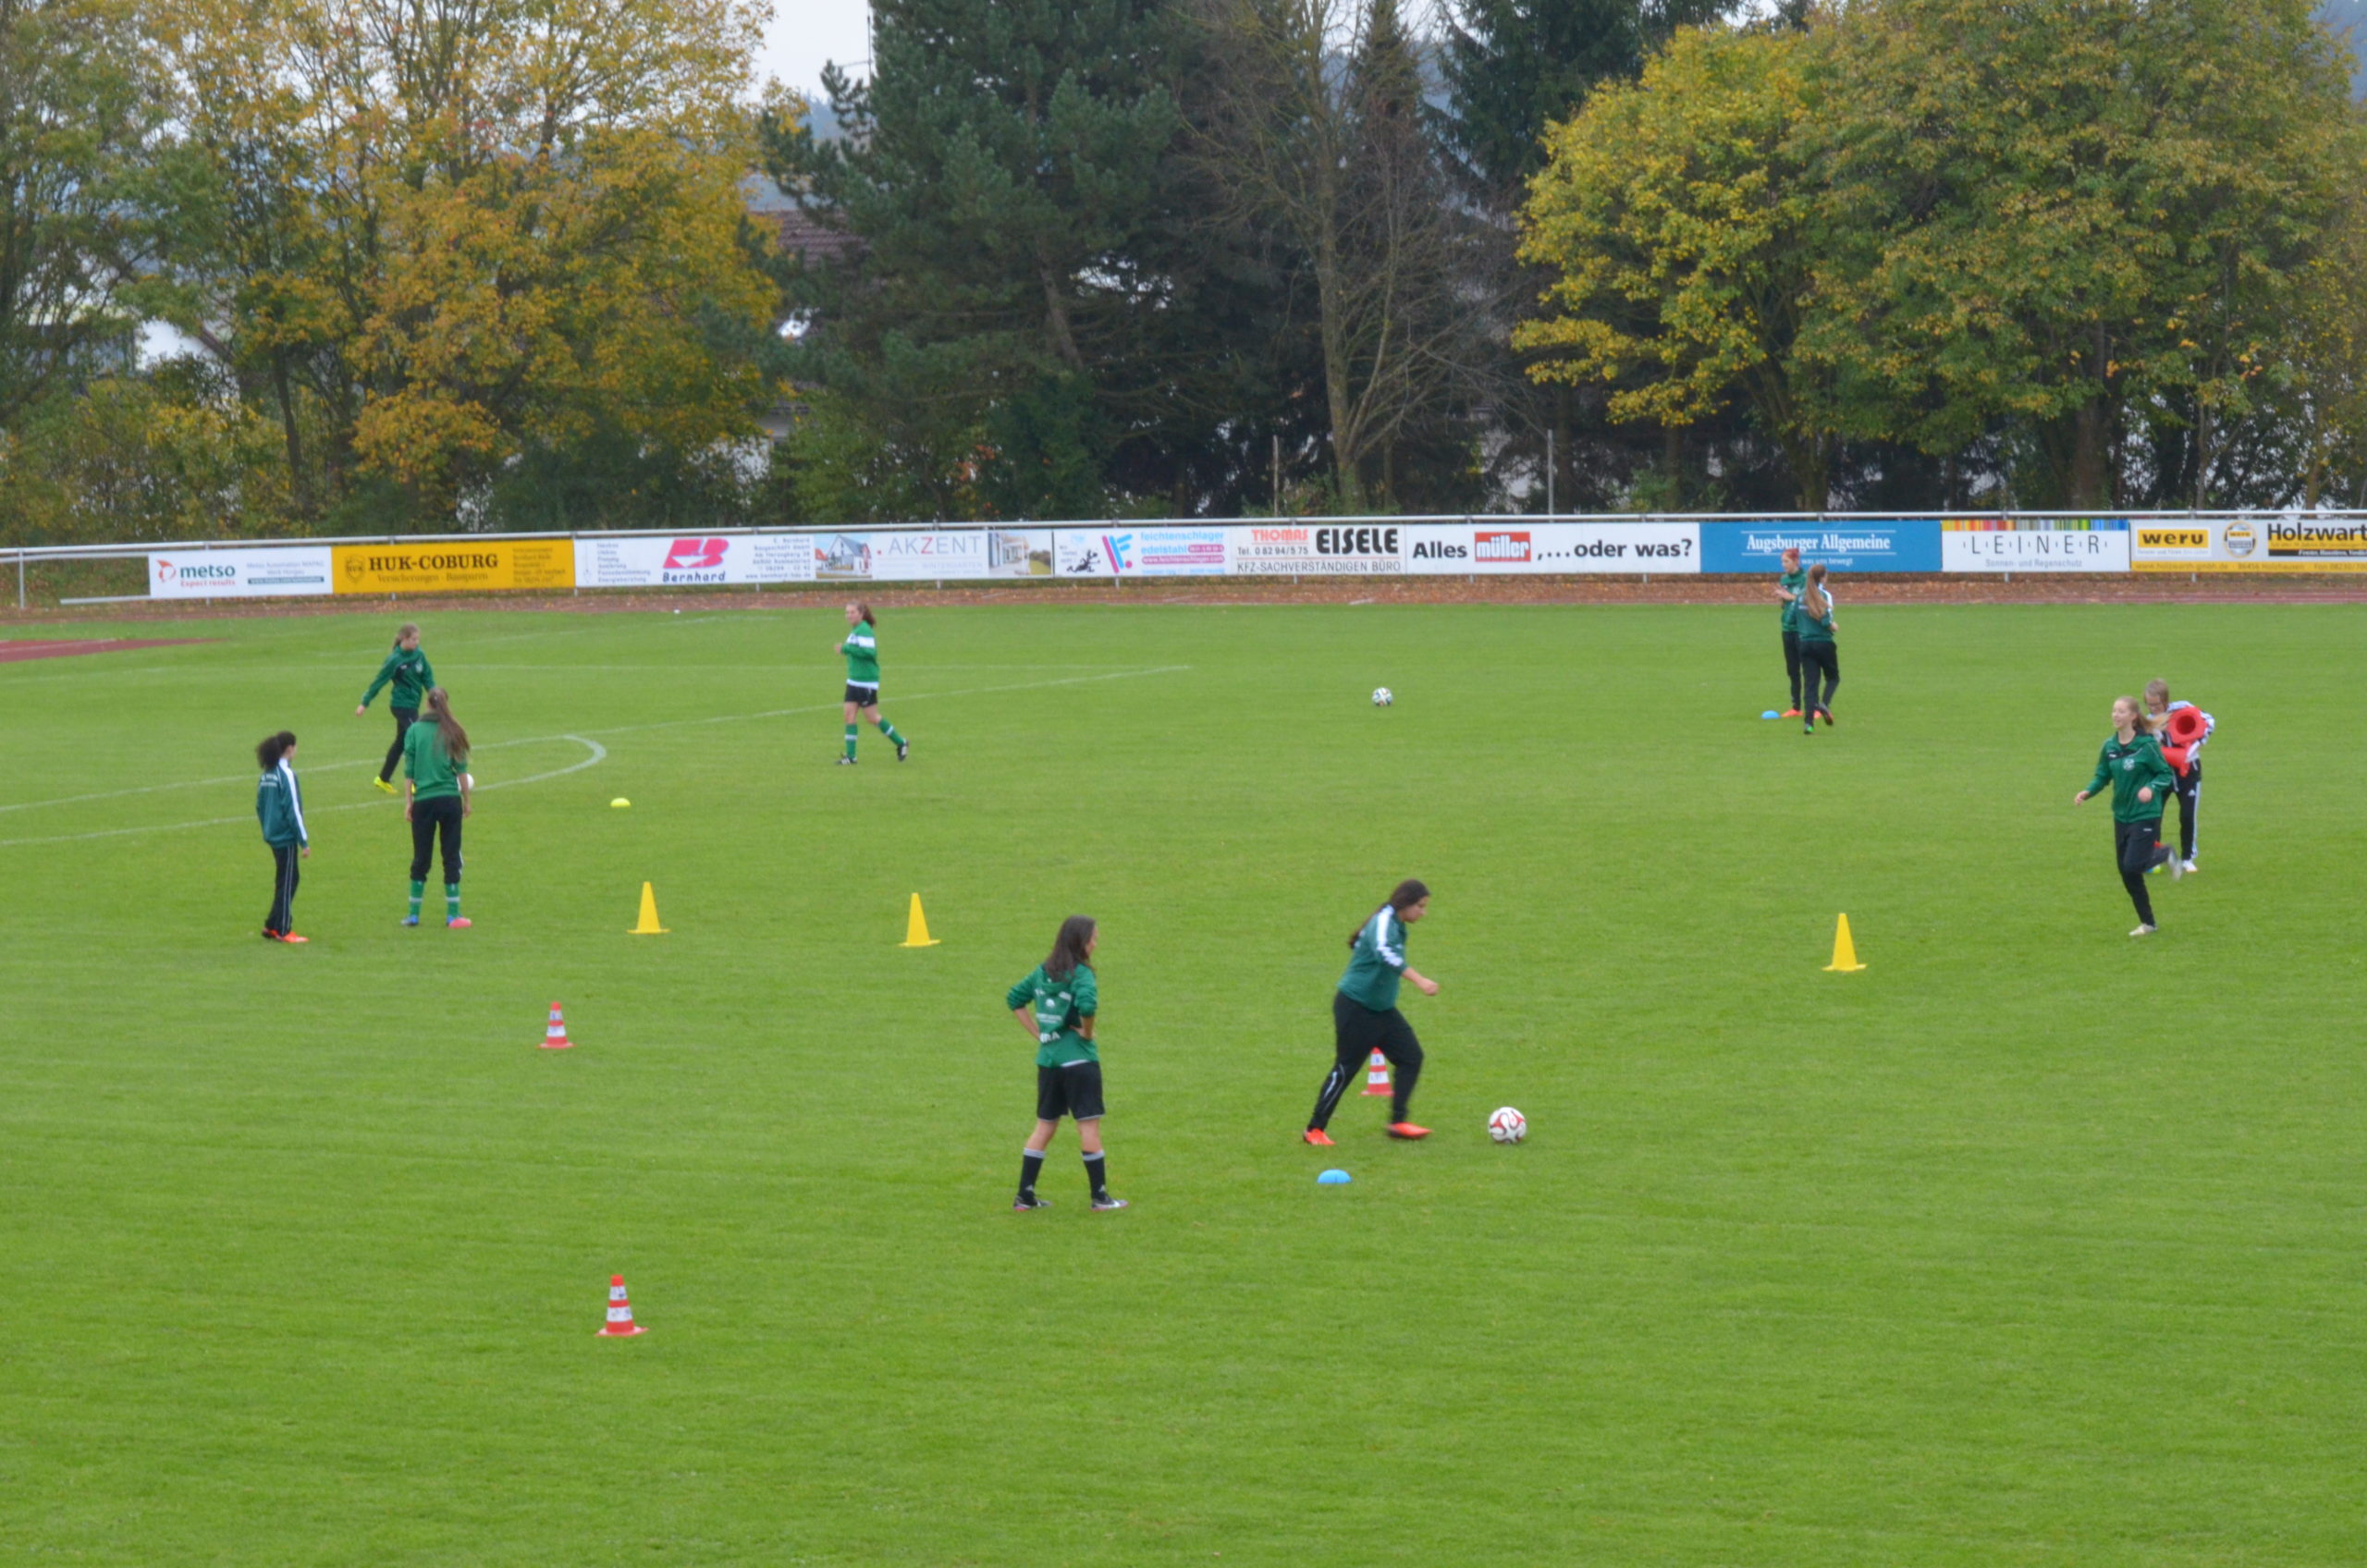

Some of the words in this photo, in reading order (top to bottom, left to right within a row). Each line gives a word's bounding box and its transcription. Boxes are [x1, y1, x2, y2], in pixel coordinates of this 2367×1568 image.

[1251, 528, 1308, 542] THOMAS
[2267, 521, 2367, 542] Holzwart
[889, 535, 982, 555] AKZENT
[1316, 528, 1398, 555] EISELE
[1747, 533, 1819, 553] Augsburger
[1821, 533, 1891, 553] Allgemeine
[2142, 533, 2203, 545] weru
[1141, 544, 1187, 555] edelstahl
[1412, 542, 1467, 559] Alles
[1476, 534, 1530, 558] müller
[1635, 539, 1692, 557] was?
[369, 554, 498, 571] HUK-COBURG
[1237, 559, 1367, 572] KFZ-SACHVERSTÄNDIGEN
[1372, 558, 1402, 572] BÜRO
[2019, 558, 2032, 568] und
[2034, 558, 2082, 569] Regenschutz
[180, 565, 236, 578] metso
[377, 573, 439, 583] Versicherungen
[663, 571, 726, 583] Bernhard
[180, 580, 206, 588] Expect
